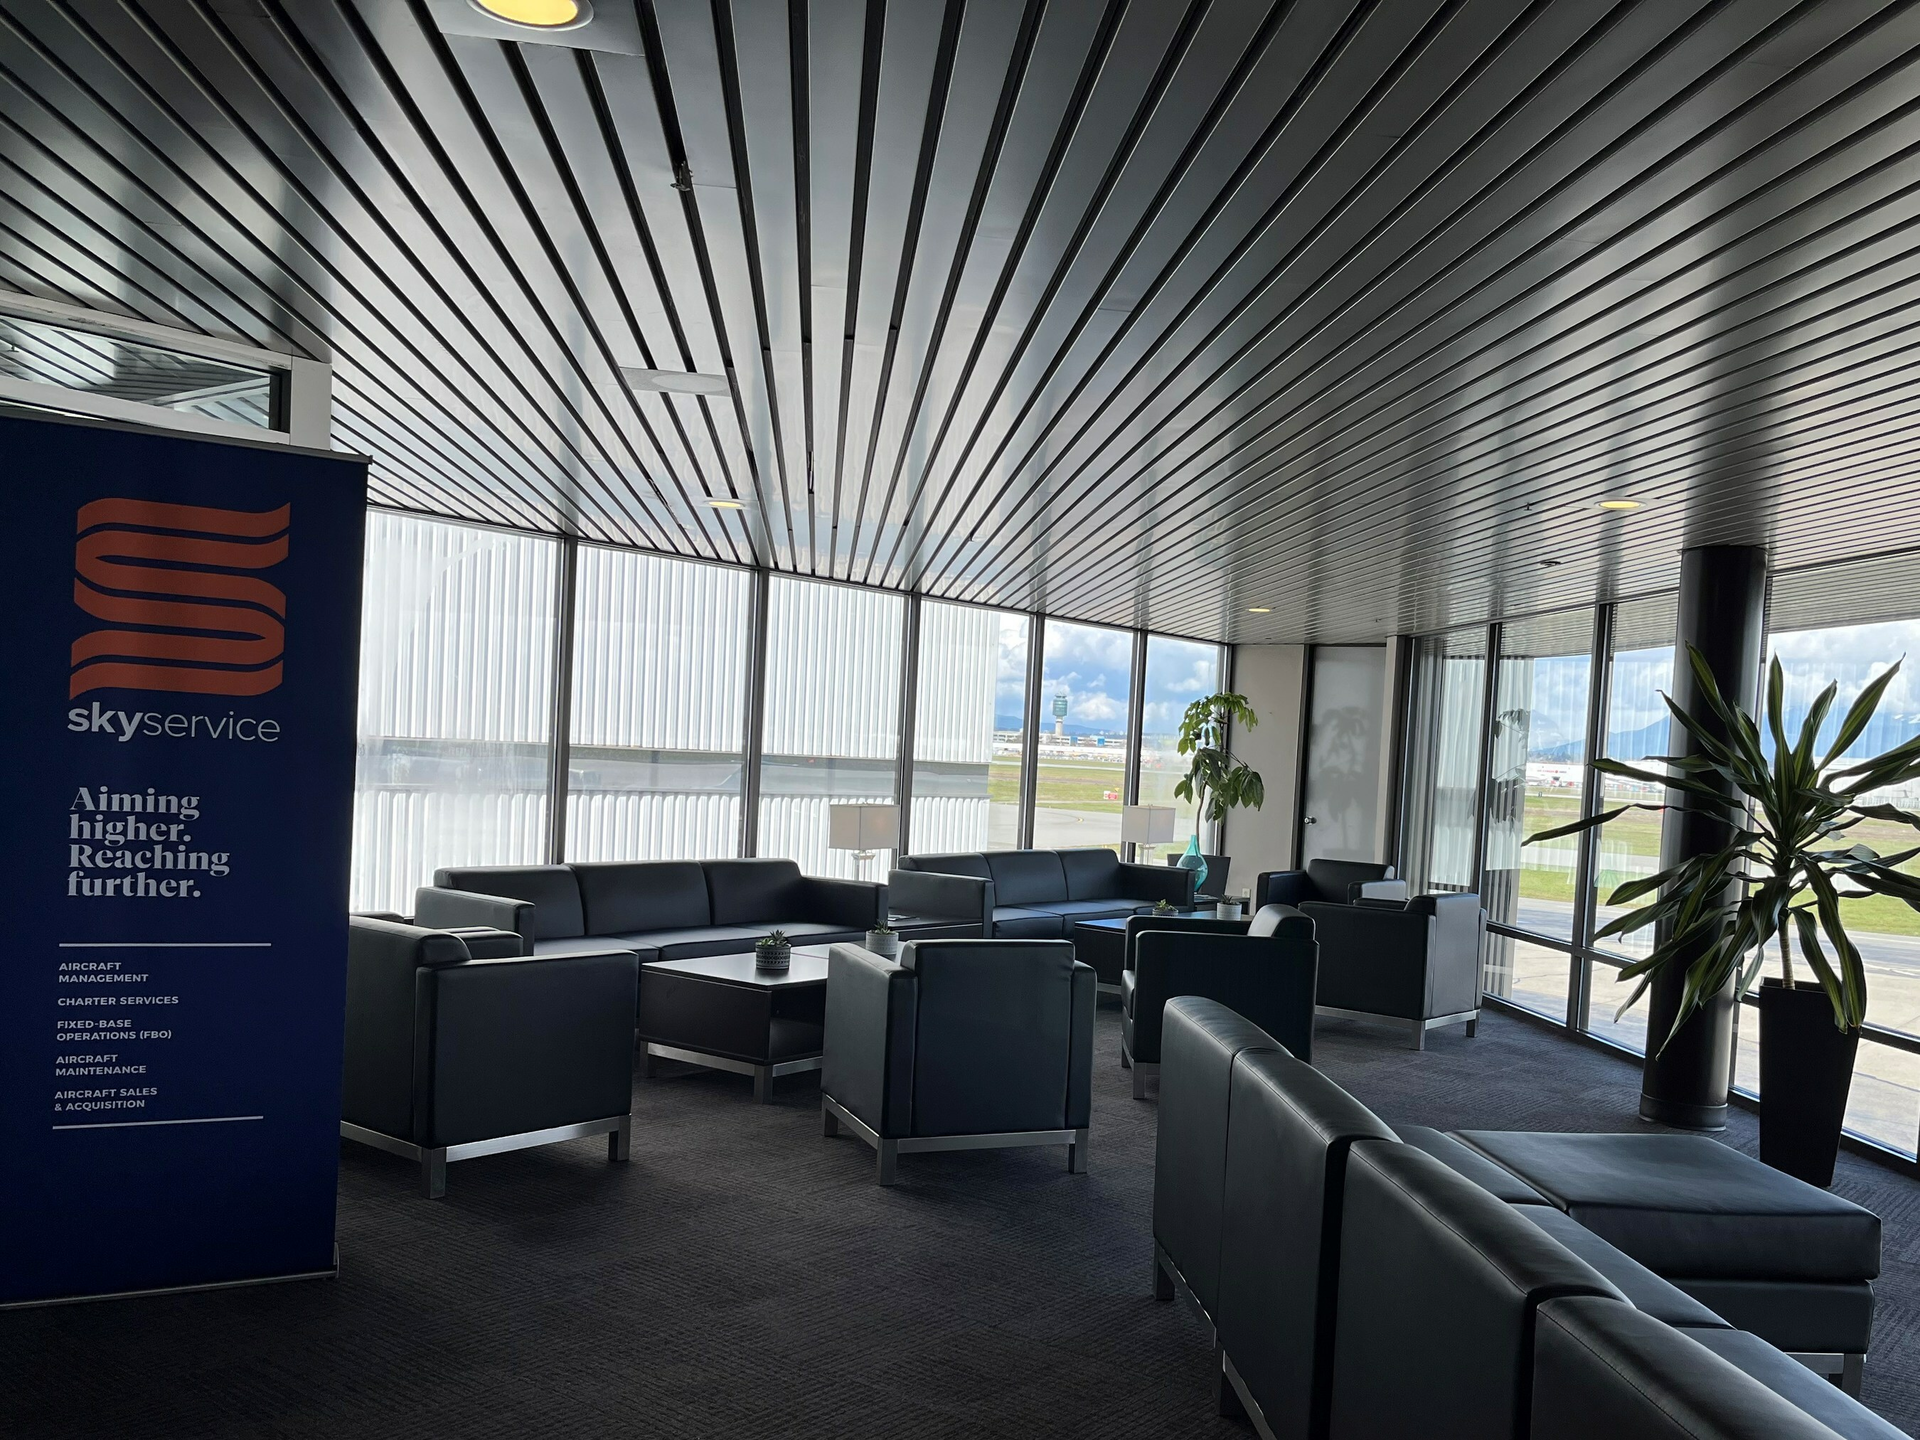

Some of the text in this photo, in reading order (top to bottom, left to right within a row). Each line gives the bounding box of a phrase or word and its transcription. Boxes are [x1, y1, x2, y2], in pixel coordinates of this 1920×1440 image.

[67, 701, 281, 742] skyservice
[69, 785, 200, 821] Aiming
[69, 813, 192, 847] higher.
[68, 844, 230, 877] Reaching
[67, 870, 201, 898] further.
[58, 962, 122, 971] AIRCRAFT
[58, 973, 149, 983] MANAGEMENT
[57, 996, 179, 1006] CHARTER SERVICES
[57, 1019, 132, 1029] FIXED-BASE
[56, 1029, 172, 1041] OPERATIONS (FBO)
[55, 1054, 119, 1064] AIRCRAFT
[55, 1065, 147, 1077] MAINTENANCE
[54, 1087, 158, 1100] AIRCRAFT SALES
[54, 1099, 145, 1112] & ACQUISITION
